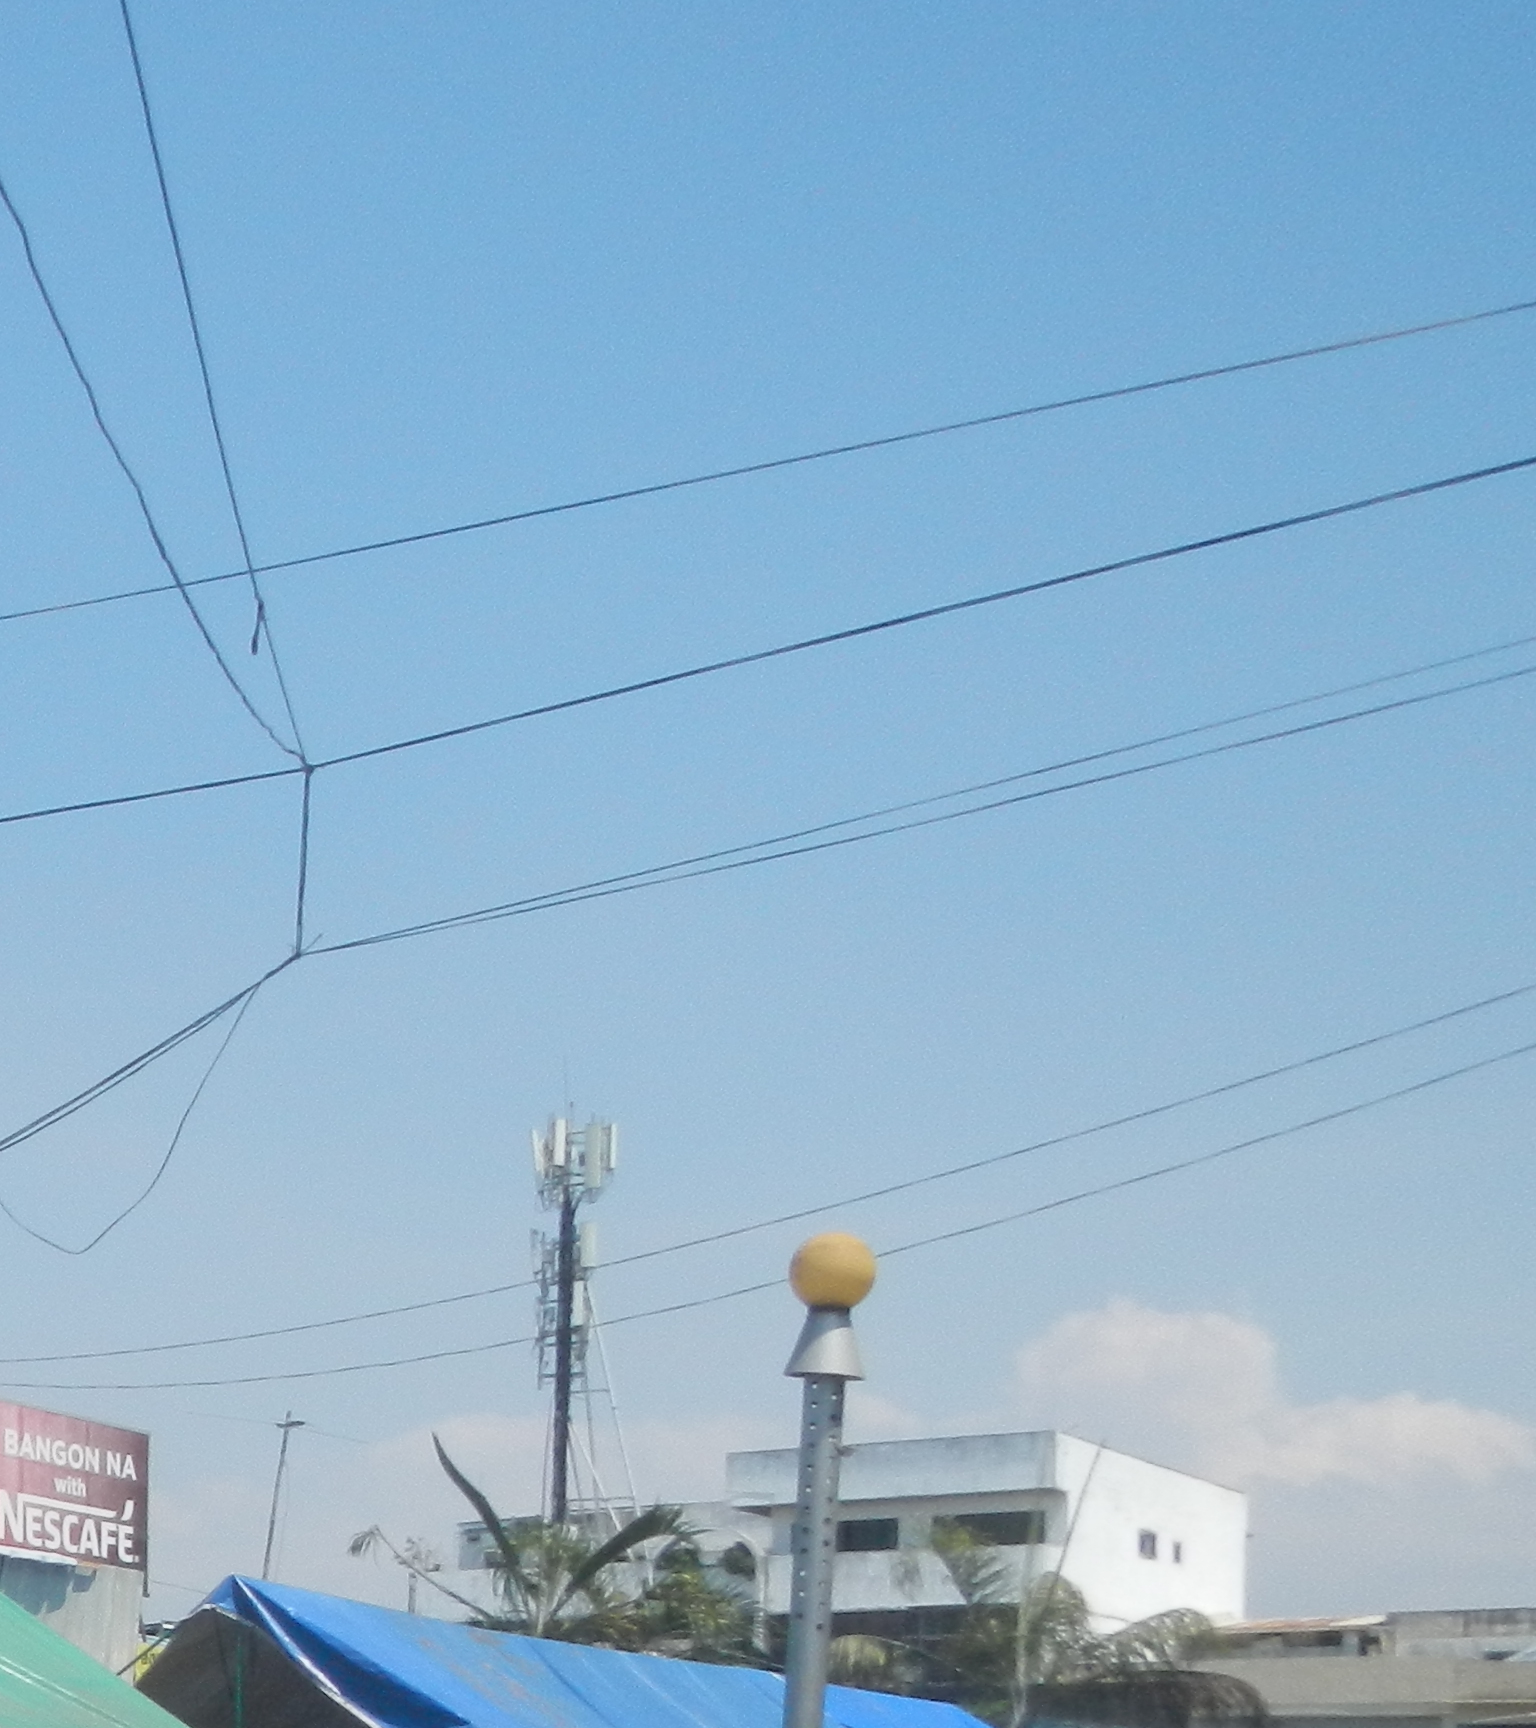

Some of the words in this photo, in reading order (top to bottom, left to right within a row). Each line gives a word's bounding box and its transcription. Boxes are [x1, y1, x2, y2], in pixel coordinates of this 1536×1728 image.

[4, 1428, 100, 1474] BANGON
[106, 1450, 137, 1481] NA
[53, 1475, 87, 1497] with
